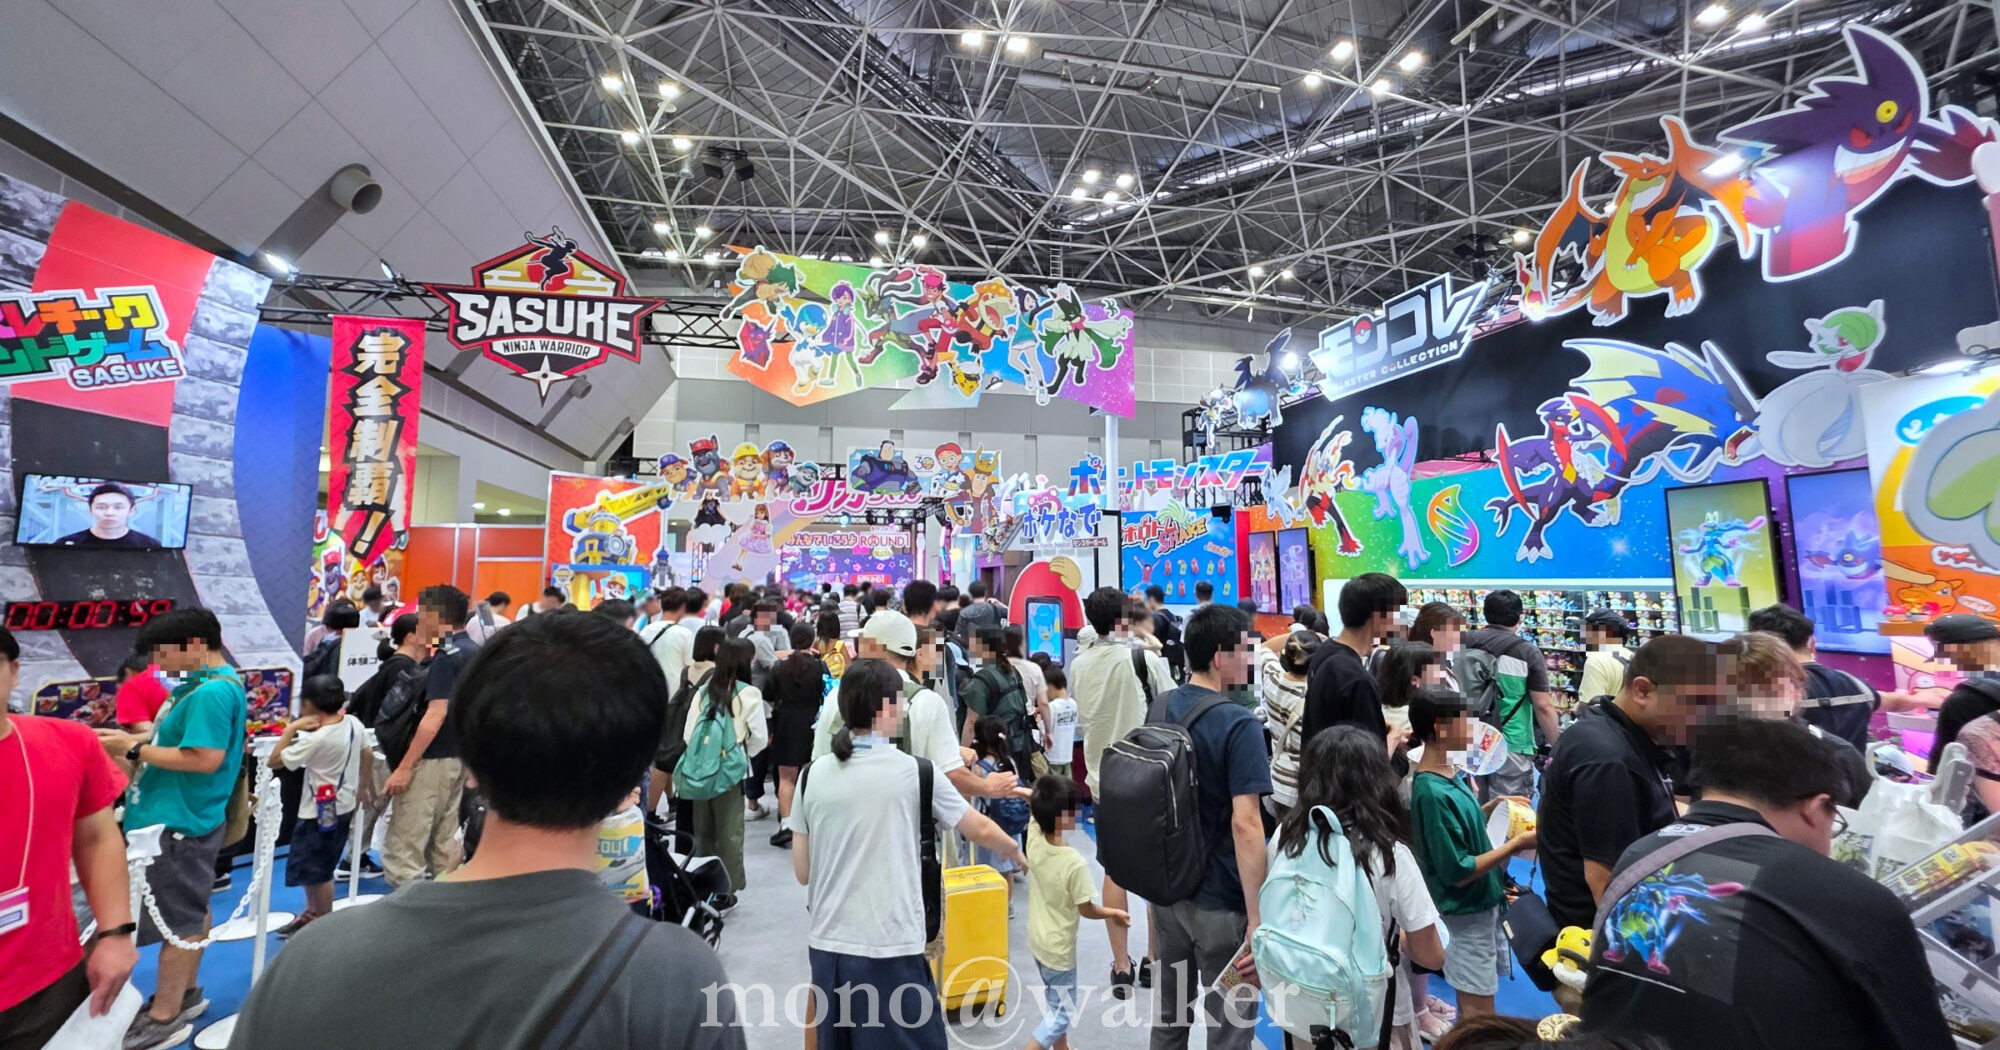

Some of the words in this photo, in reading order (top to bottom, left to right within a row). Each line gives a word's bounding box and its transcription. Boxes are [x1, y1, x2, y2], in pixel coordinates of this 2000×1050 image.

[447, 292, 644, 352] SASUKE
[503, 341, 536, 352] NINJA
[539, 340, 591, 357] WARRIOR
[1380, 340, 1458, 375] COLLECTION
[72, 360, 181, 387] SASUKE
[1023, 503, 1102, 538] ポケなで
[860, 533, 910, 547] ROUND1
